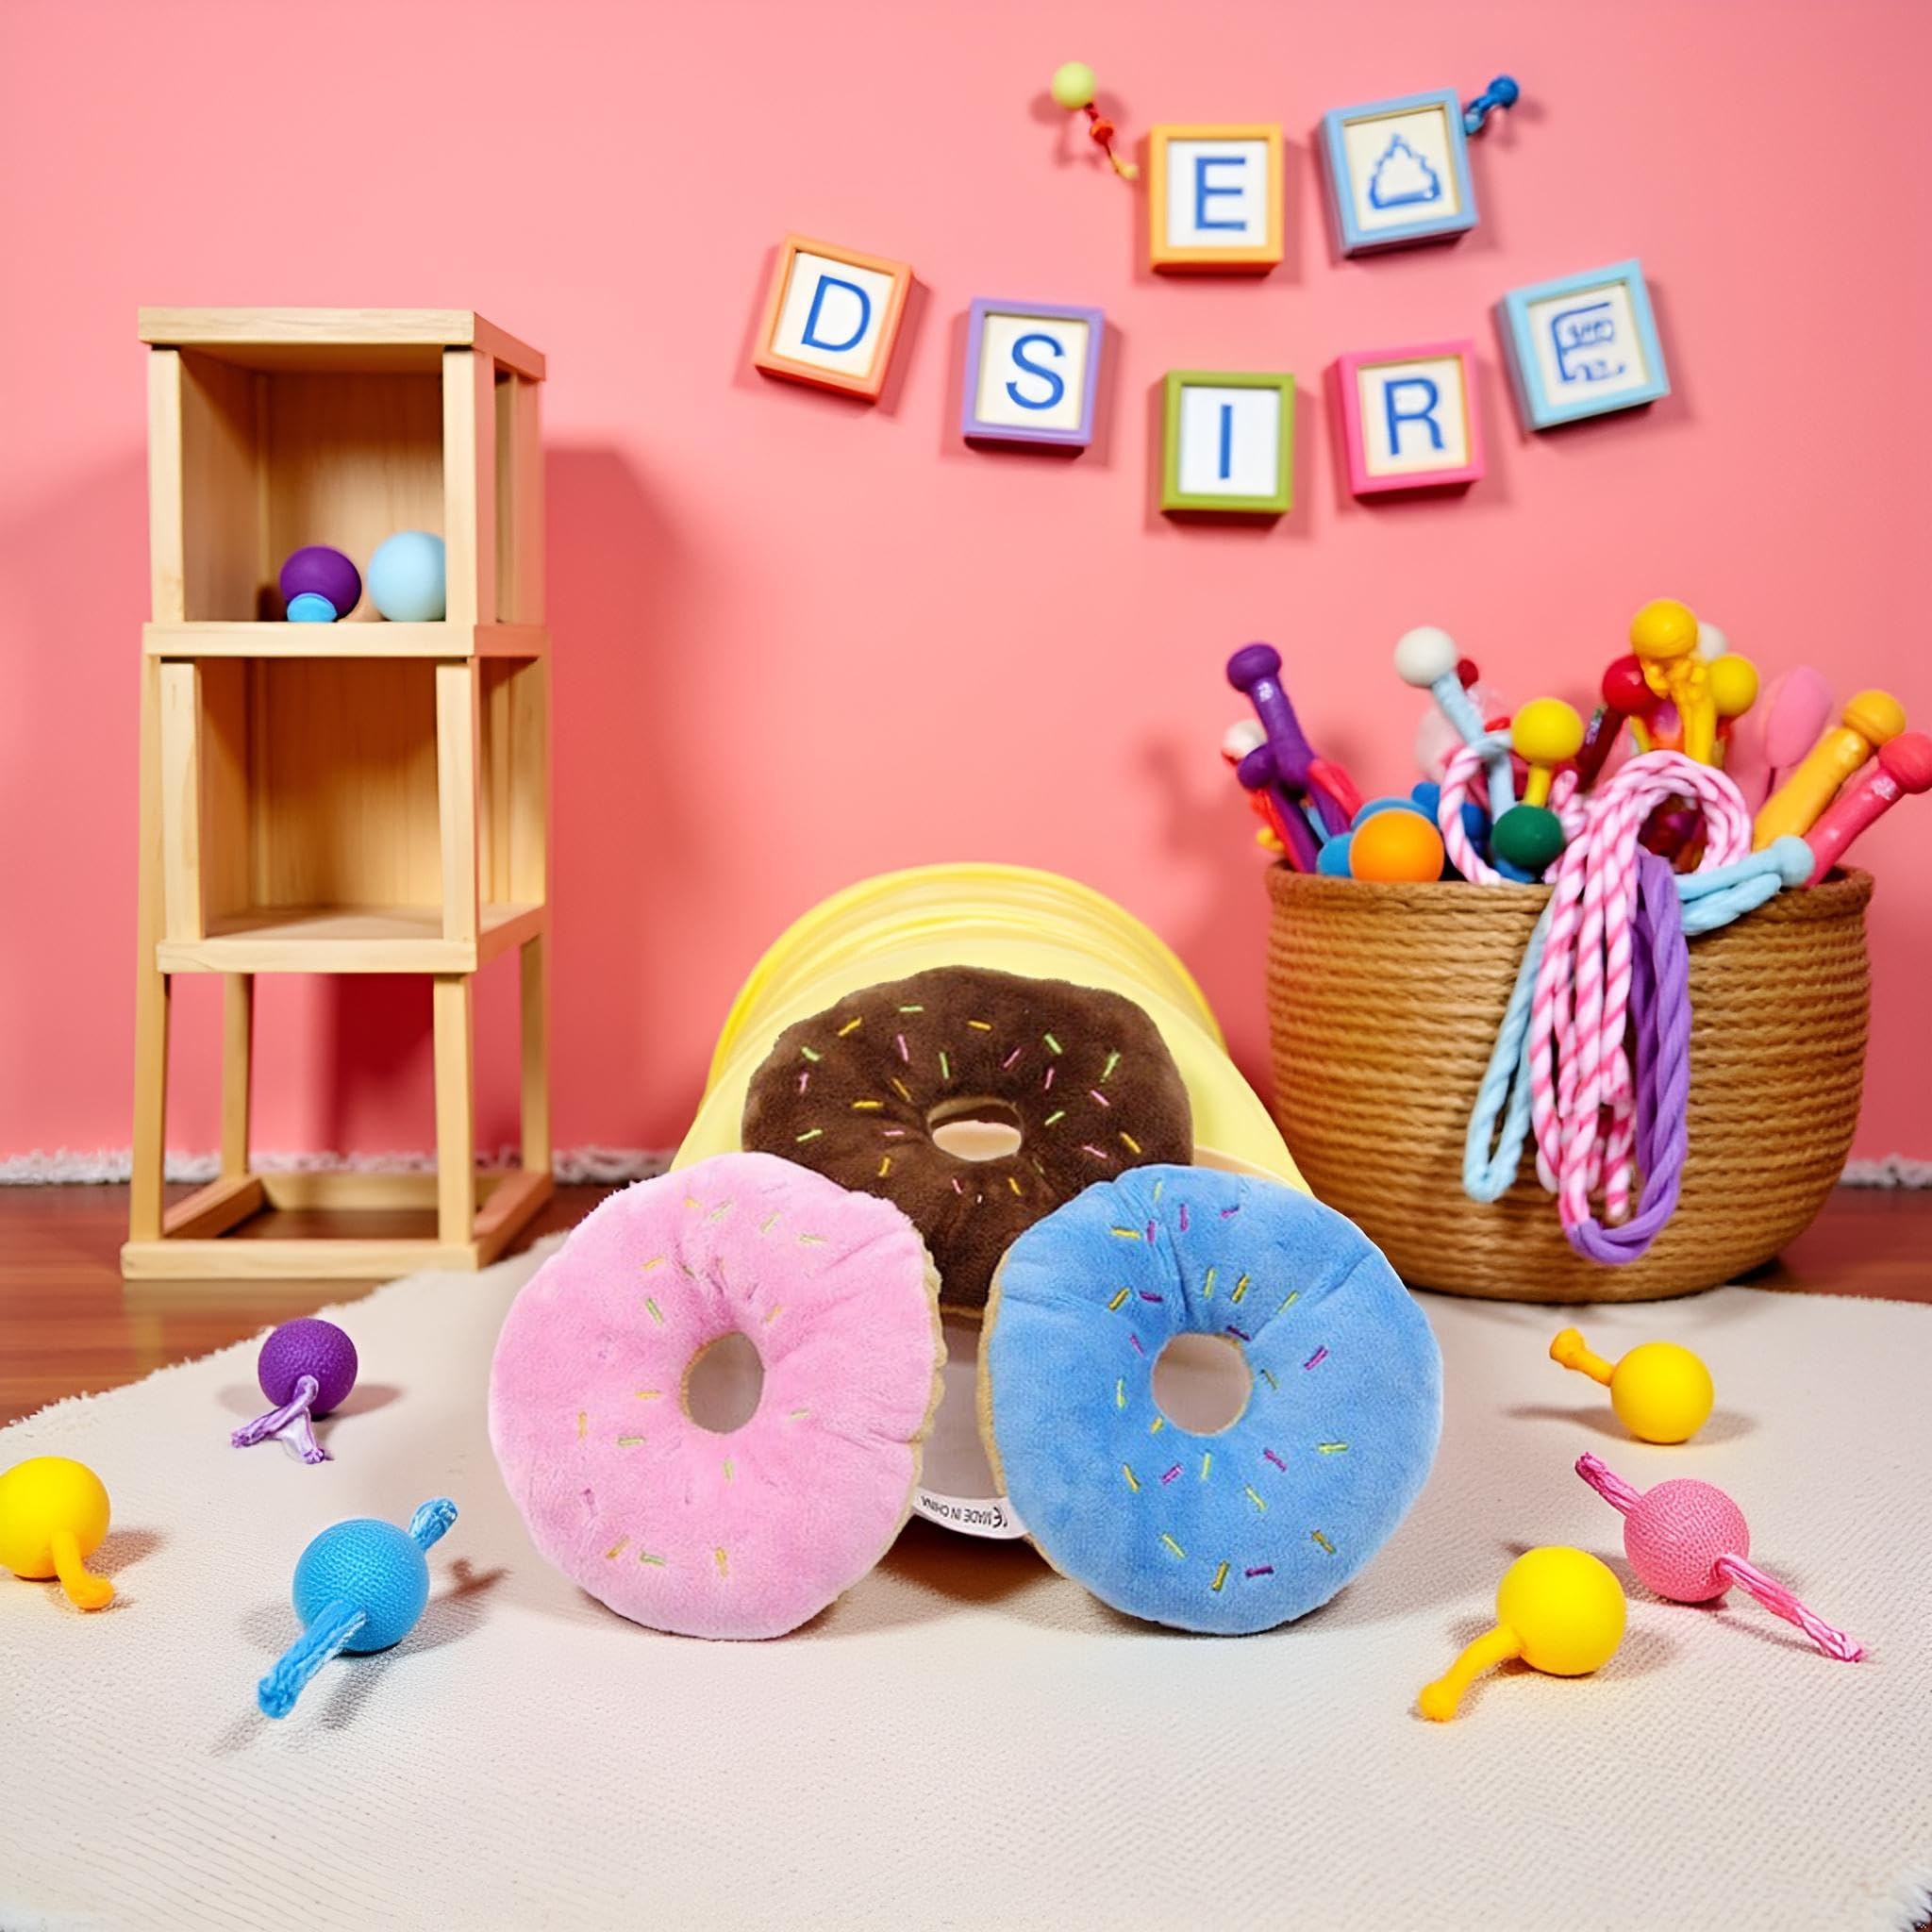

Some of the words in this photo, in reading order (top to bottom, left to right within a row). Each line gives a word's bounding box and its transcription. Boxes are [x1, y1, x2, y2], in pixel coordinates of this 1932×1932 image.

[1195, 157, 1247, 232] E
[801, 275, 872, 353] D
[1006, 333, 1065, 411] S
[1217, 403, 1234, 480] I
[1382, 376, 1445, 458] R
[950, 1507, 962, 1521] IN
[963, 1508, 992, 1525] MADE
